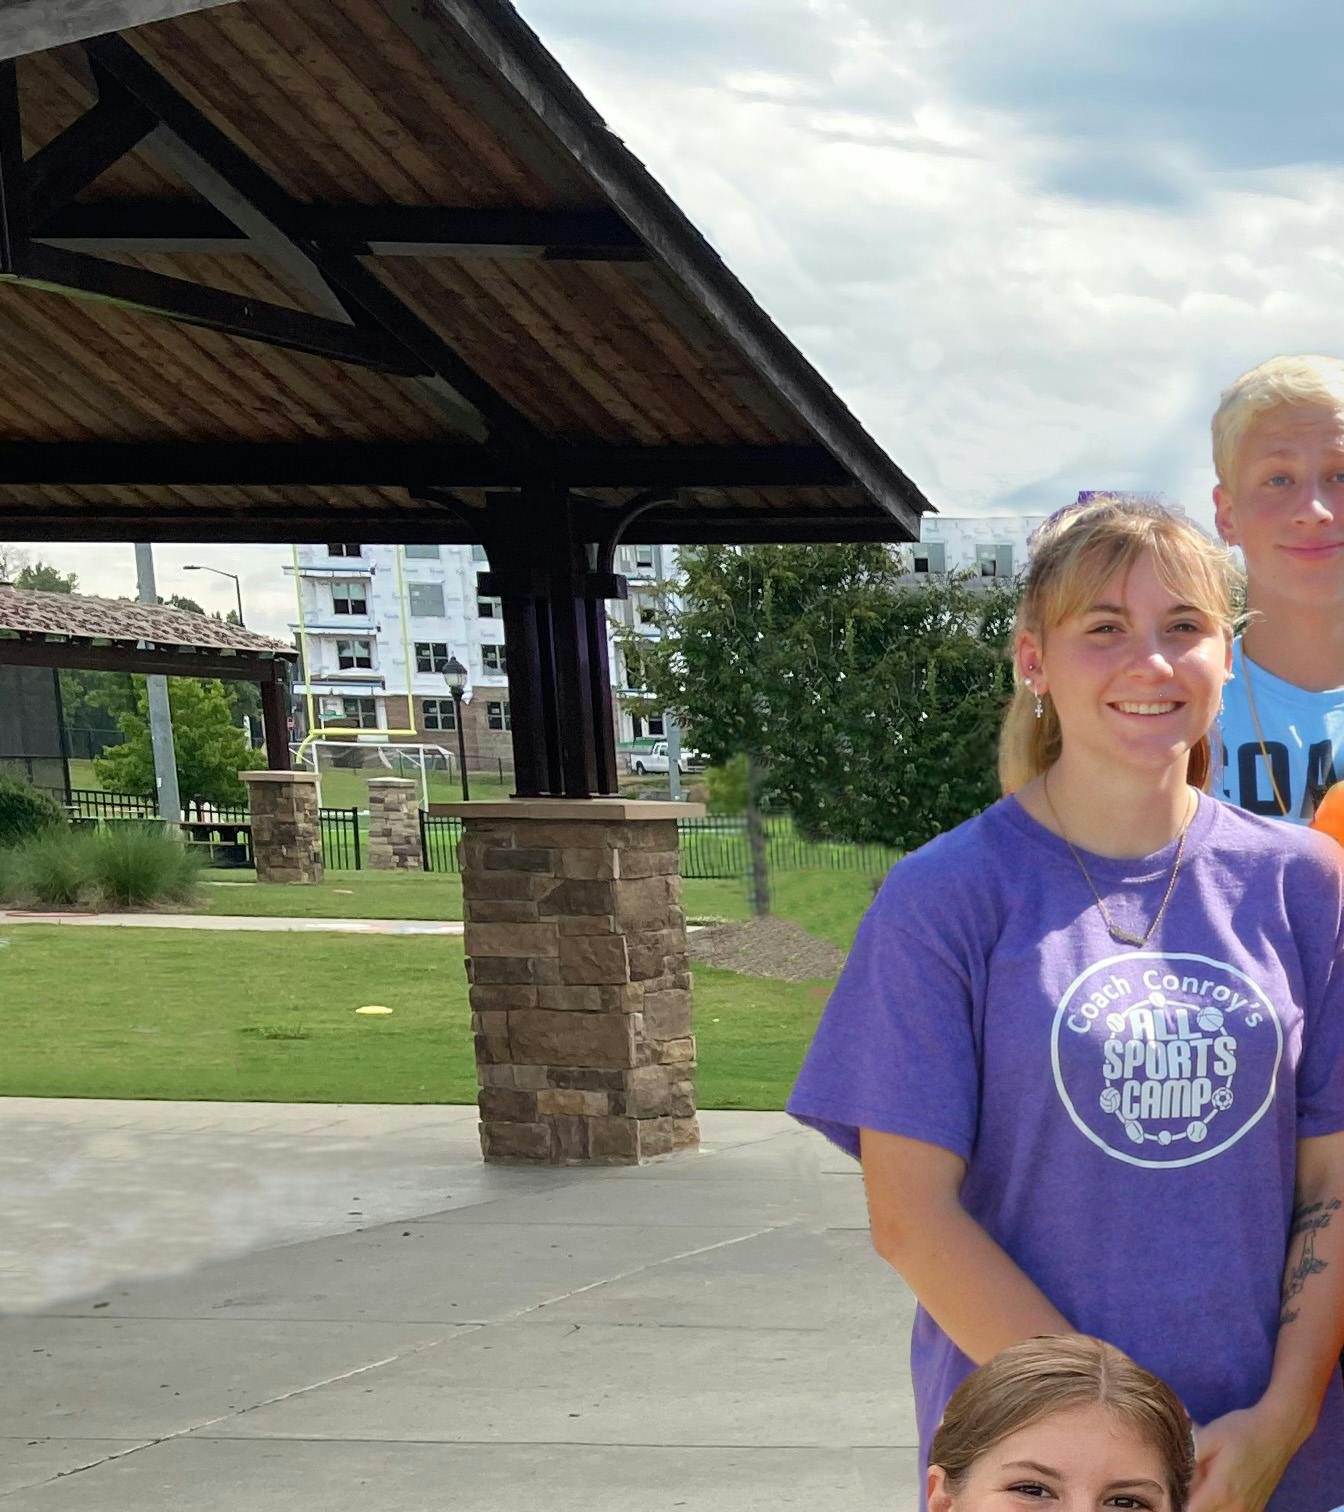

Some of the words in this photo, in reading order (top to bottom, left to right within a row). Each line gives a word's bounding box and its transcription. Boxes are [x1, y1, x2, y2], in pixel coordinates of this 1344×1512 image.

[1067, 974, 1132, 1035] Coach
[1143, 969, 1265, 1029] Conroy's
[1129, 1007, 1203, 1041] ALL
[1102, 1036, 1238, 1080] SPORTS
[1121, 1078, 1213, 1121] CAMP
